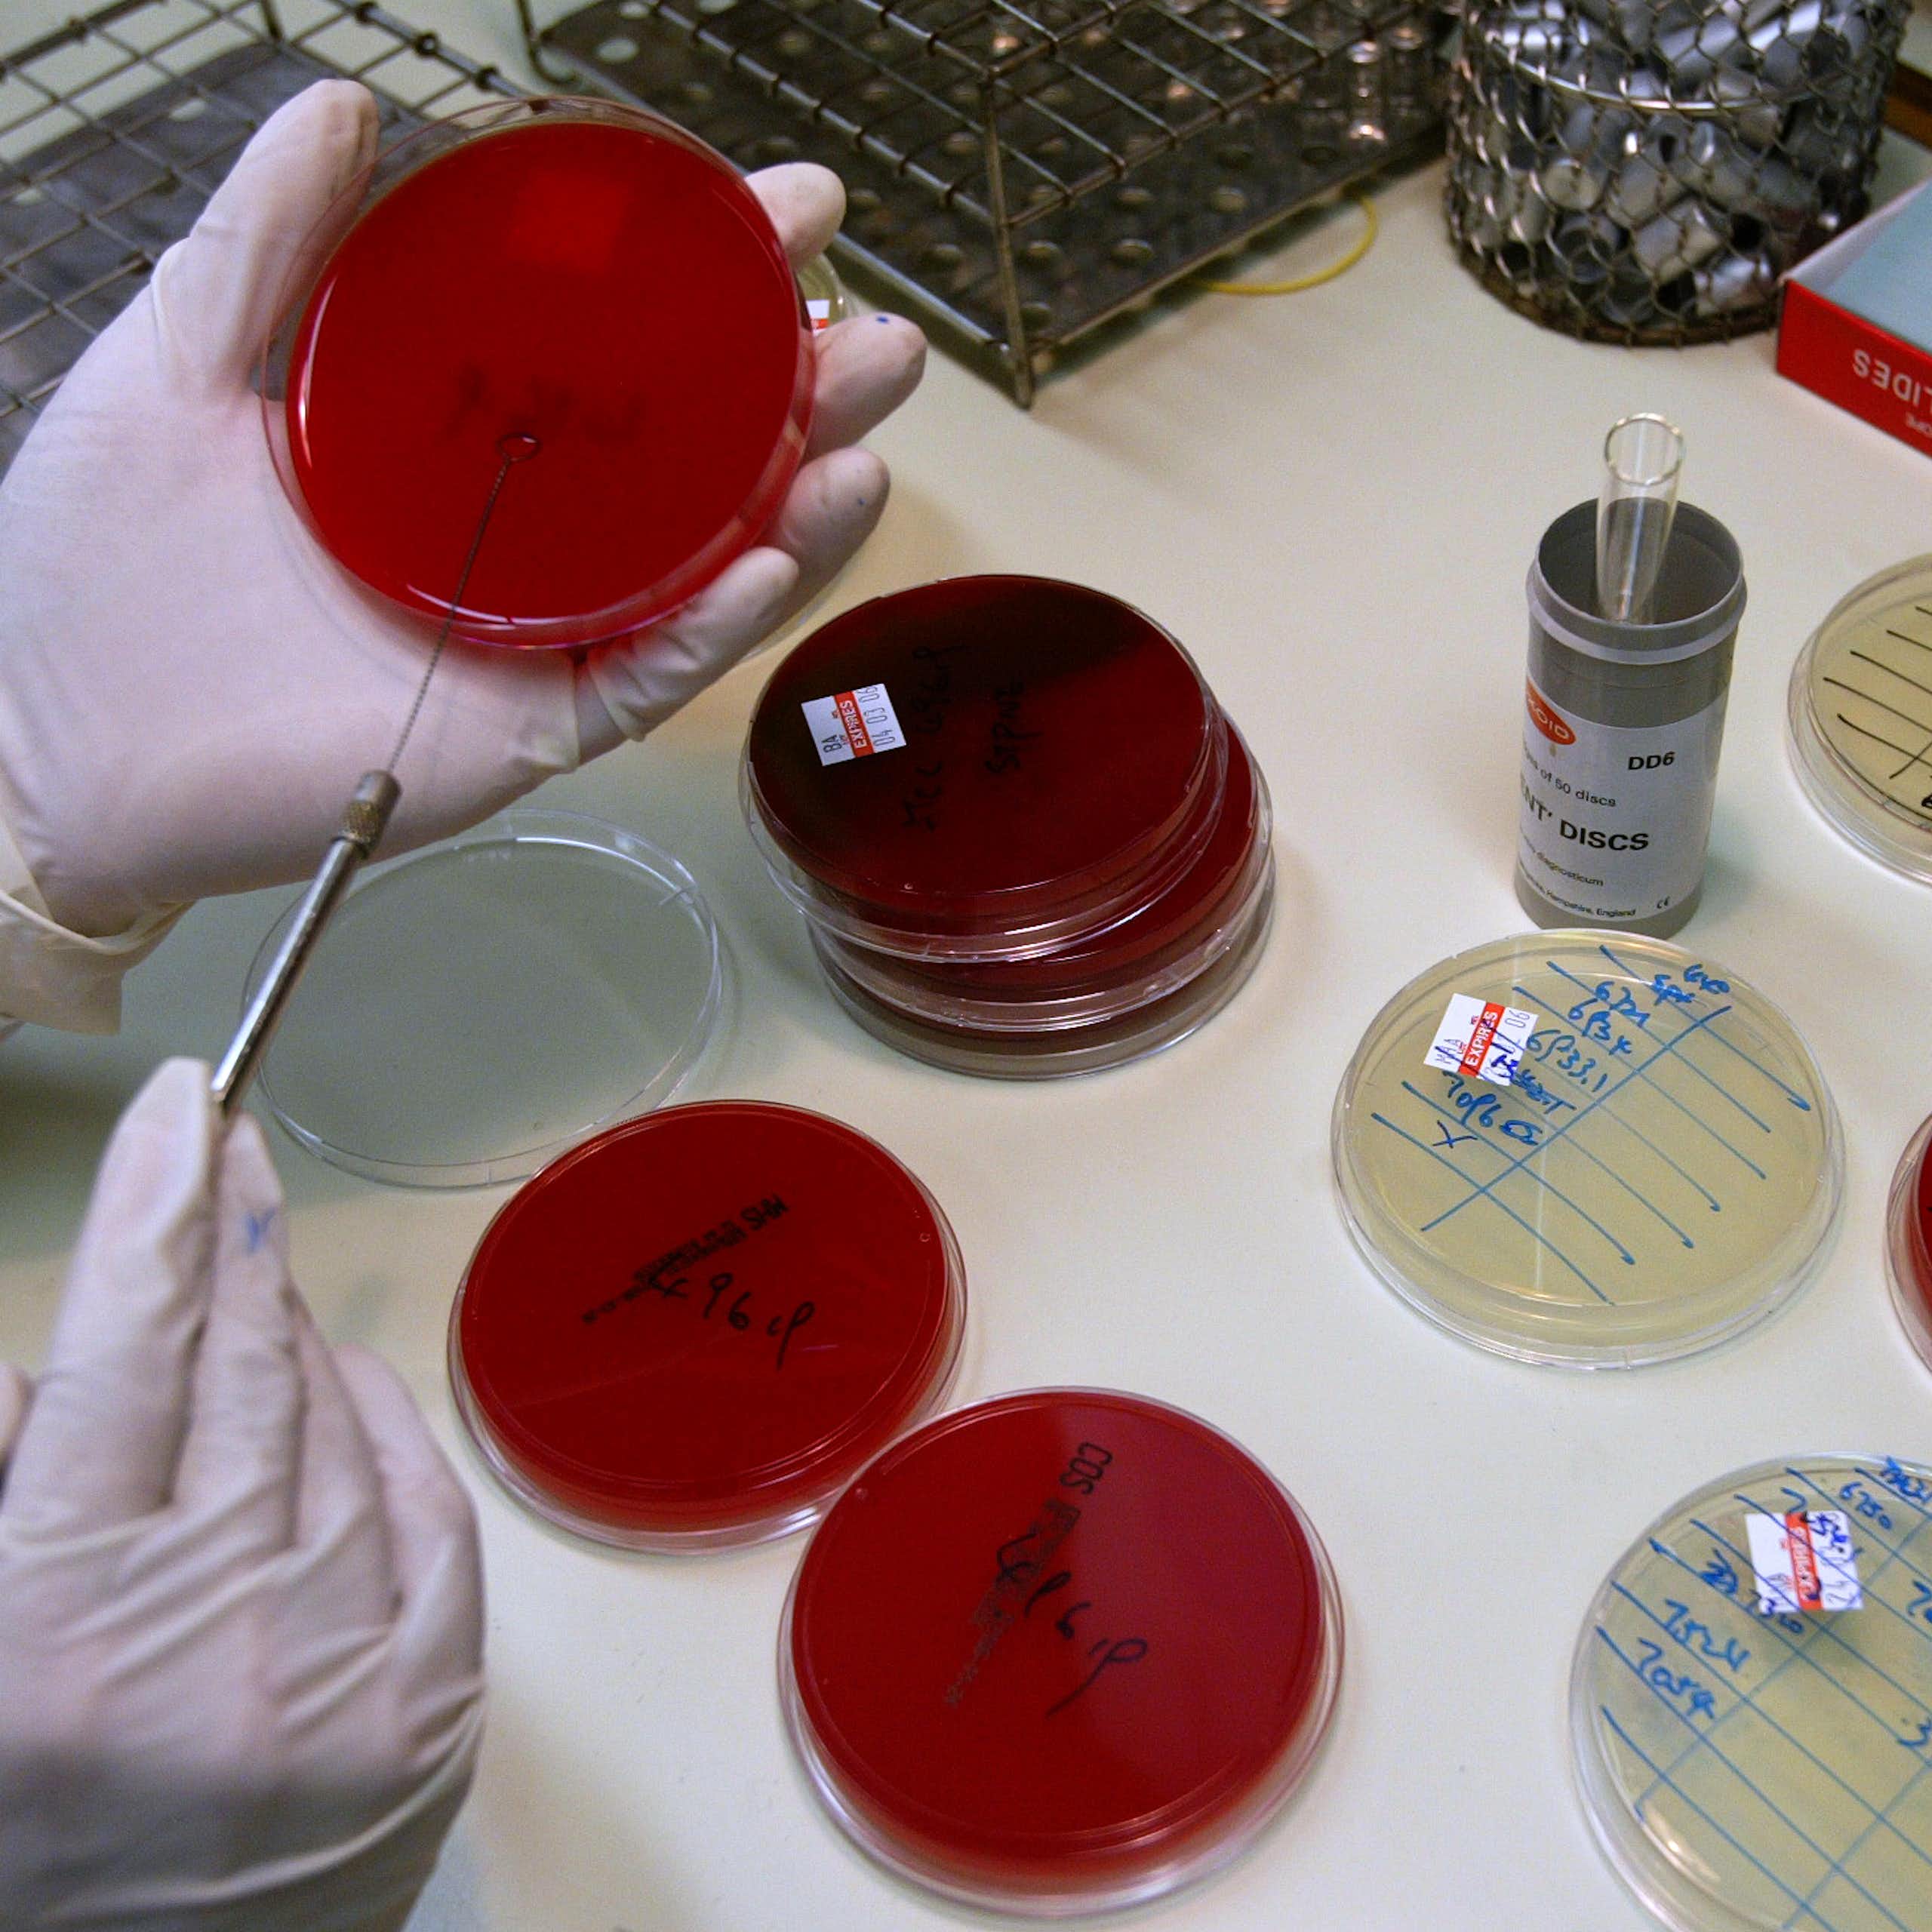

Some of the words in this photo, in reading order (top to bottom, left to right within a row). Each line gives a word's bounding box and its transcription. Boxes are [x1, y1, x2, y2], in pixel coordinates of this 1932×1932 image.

[839, 700, 868, 749] EXPIRES
[821, 734, 843, 753] BA
[1628, 752, 1675, 771] DD6
[1555, 778, 1571, 794] 50
[1575, 790, 1617, 808] discs
[1559, 819, 1650, 851] DISCS
[1464, 1011, 1499, 1067] EXPIRES
